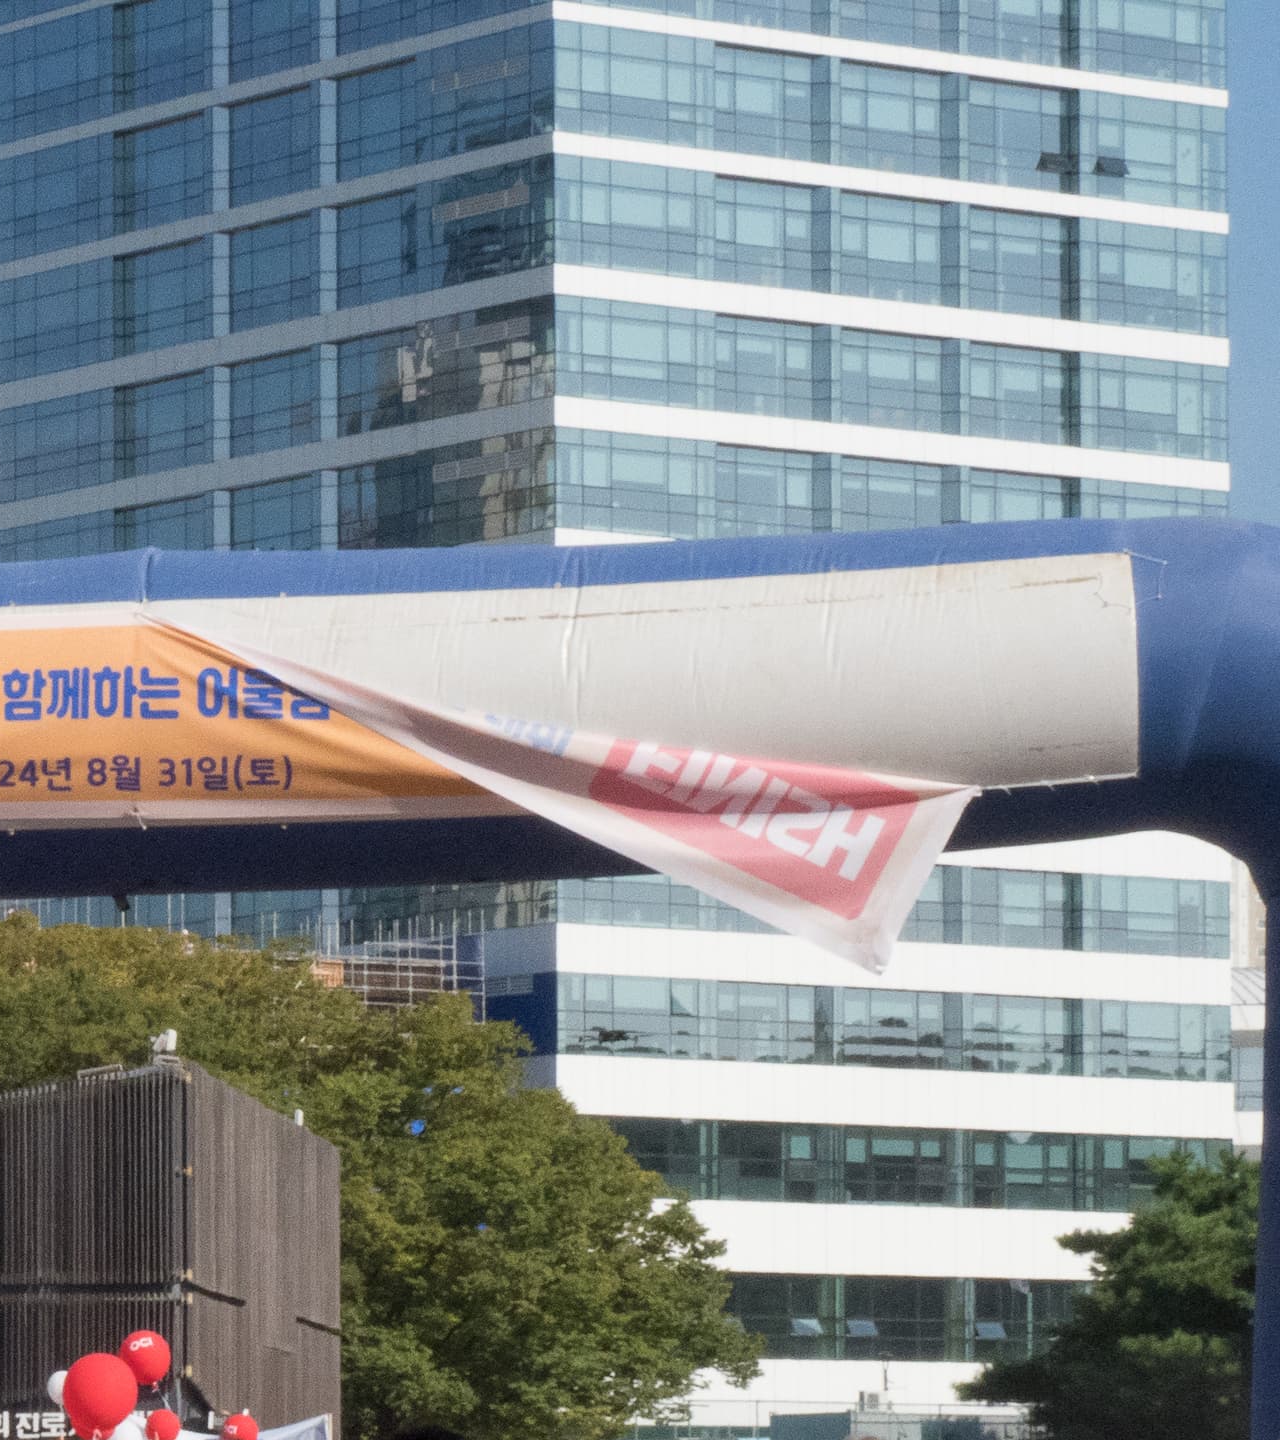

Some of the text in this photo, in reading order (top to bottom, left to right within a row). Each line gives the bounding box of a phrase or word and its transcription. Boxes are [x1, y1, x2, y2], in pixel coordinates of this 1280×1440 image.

[2, 666, 180, 720] 함께하는
[87, 755, 141, 791] 8월
[158, 755, 293, 791] 31일(토)
